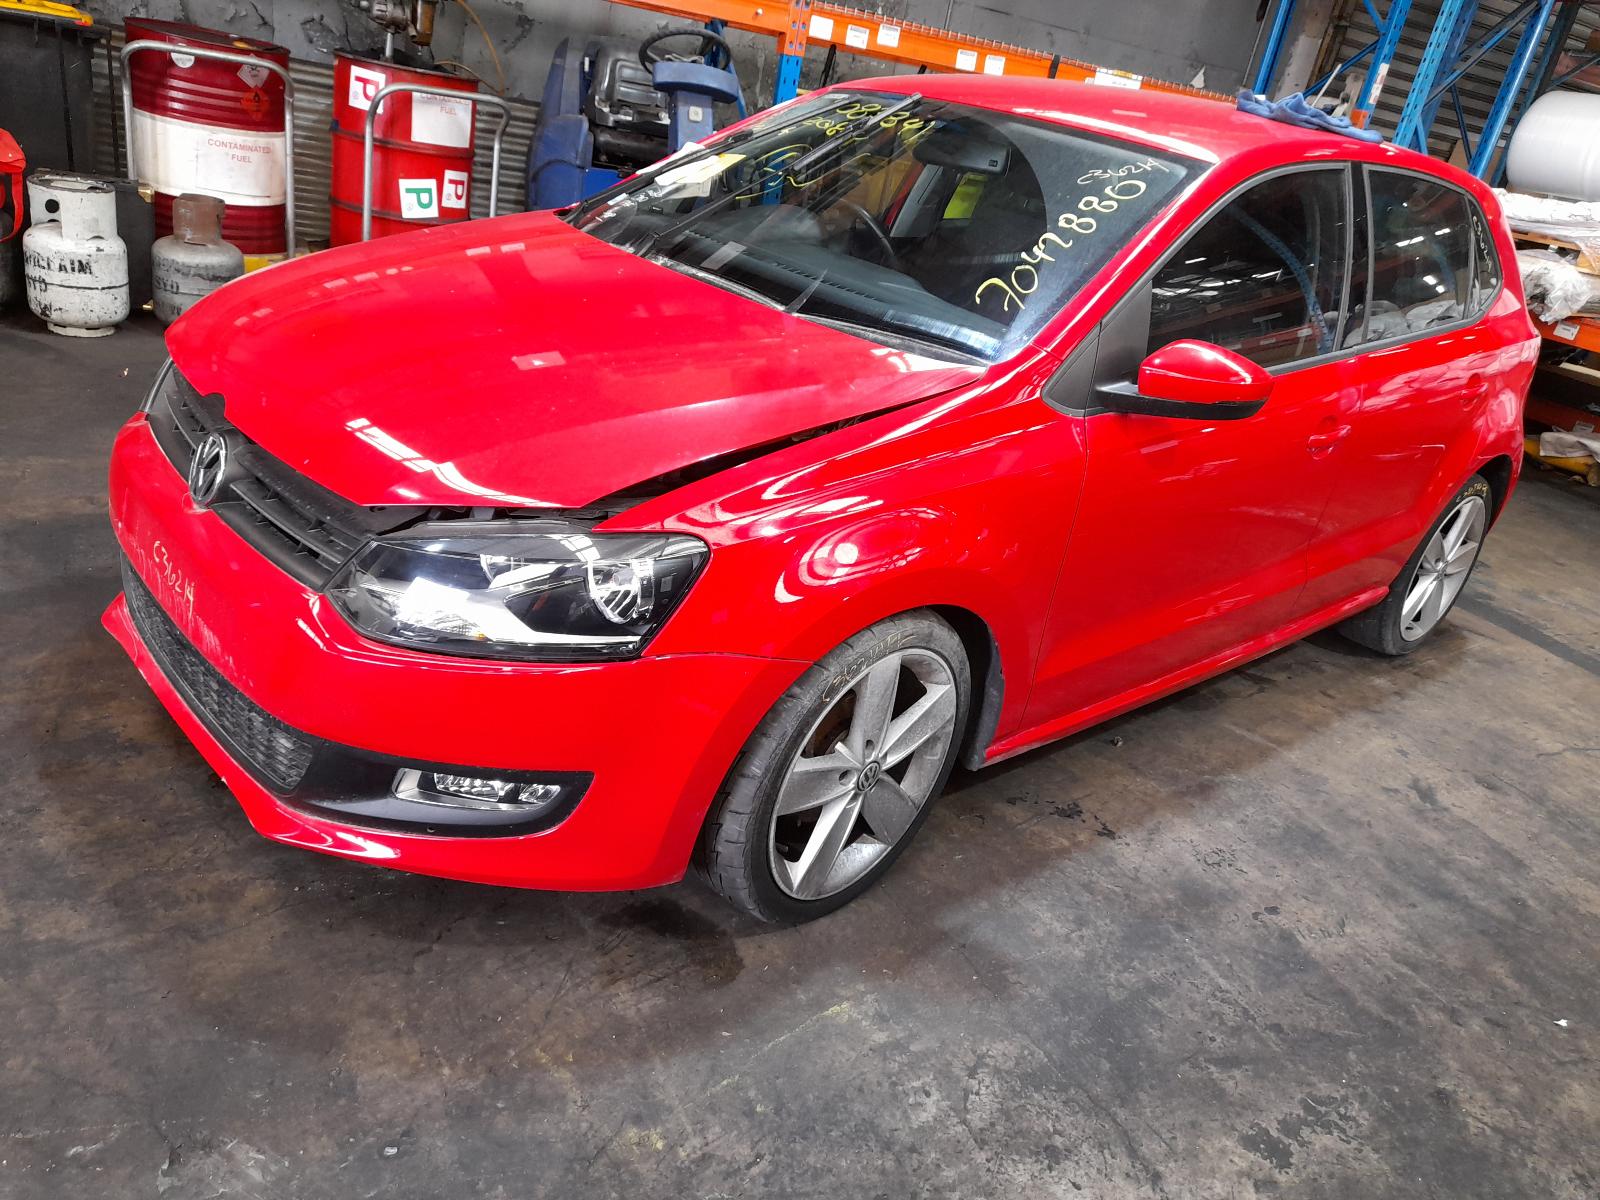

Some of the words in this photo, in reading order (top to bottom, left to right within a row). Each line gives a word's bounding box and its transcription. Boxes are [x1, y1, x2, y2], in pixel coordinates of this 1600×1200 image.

[355, 75, 380, 103] P
[207, 138, 273, 154] CONTAMINATED
[231, 153, 253, 164] FUEL
[405, 188, 433, 209] P
[448, 178, 465, 201] P
